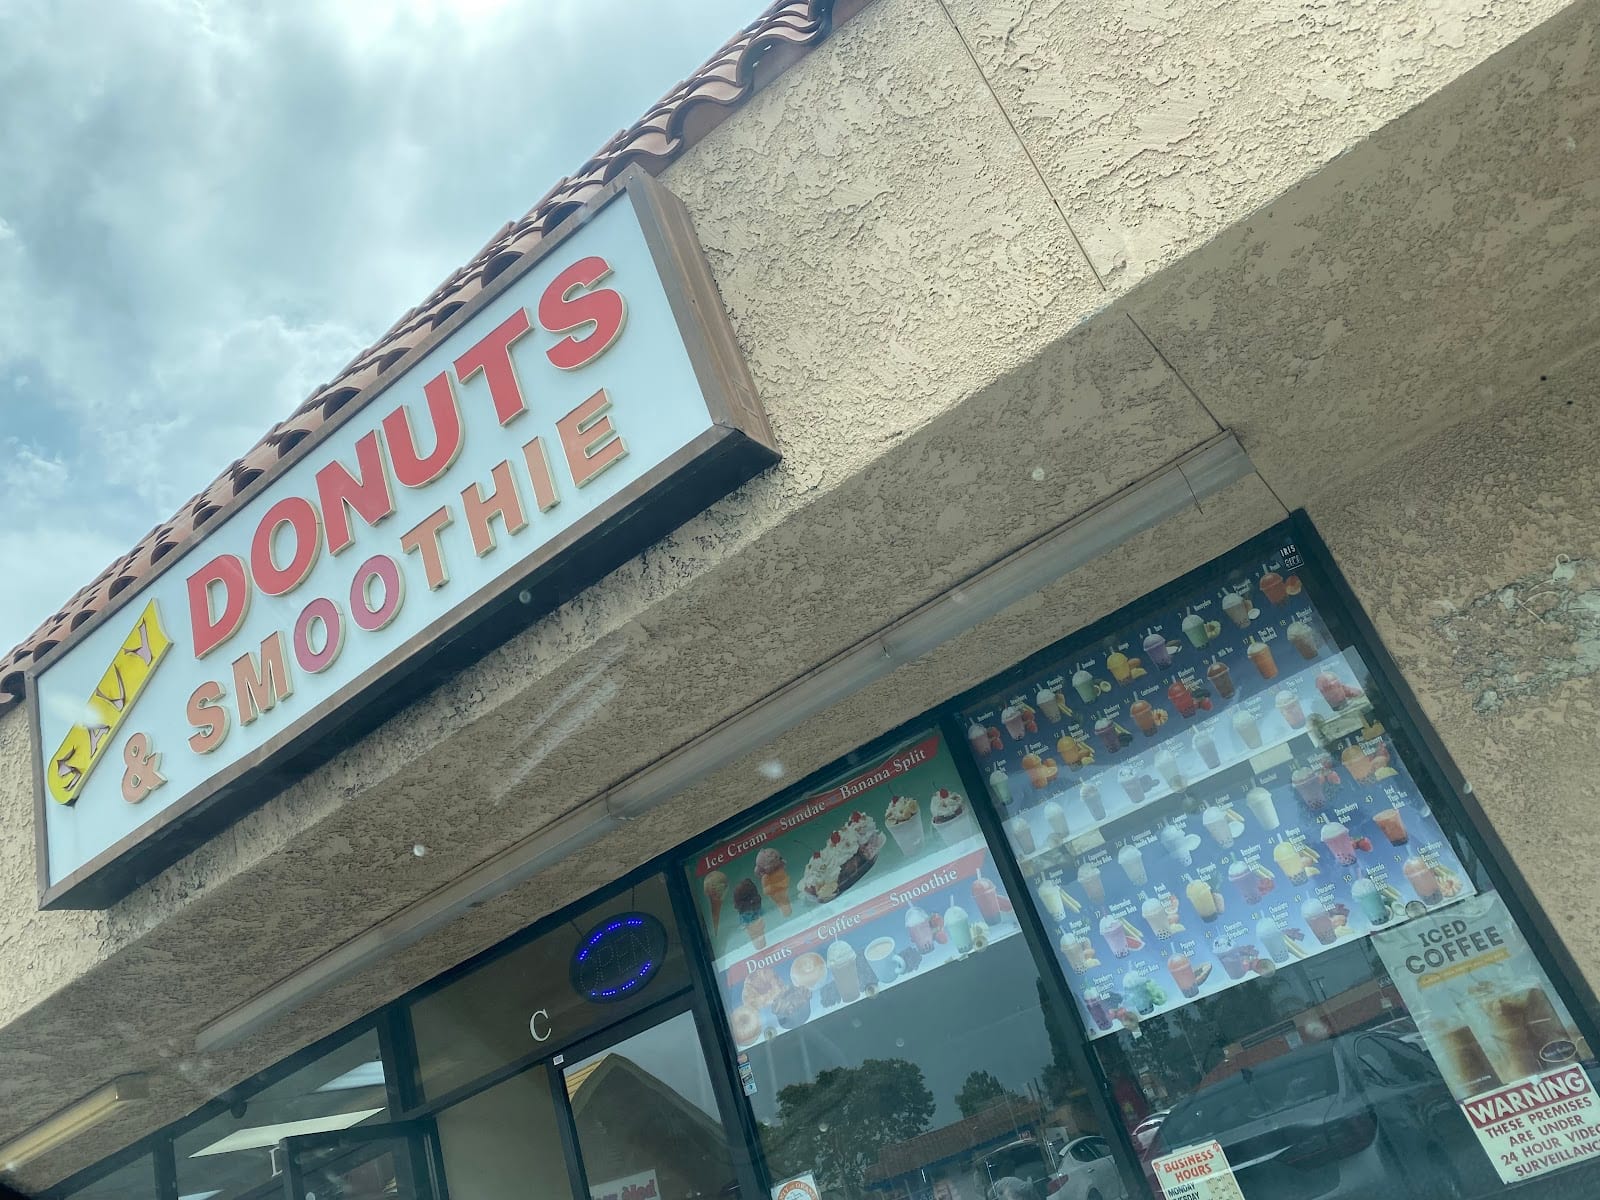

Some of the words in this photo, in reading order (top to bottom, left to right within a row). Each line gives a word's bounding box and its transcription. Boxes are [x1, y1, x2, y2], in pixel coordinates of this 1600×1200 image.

[186, 256, 628, 660] DONUTS
[122, 733, 168, 804] &
[187, 388, 629, 756] SMOOTHIE
[705, 852, 725, 870] Ice
[726, 830, 768, 858] Cream
[779, 800, 826, 831] Sundae
[839, 768, 891, 801] Banana
[892, 749, 927, 774] Split
[745, 946, 792, 975] Donuts
[816, 912, 862, 942] Coffee
[889, 868, 959, 908] Smoothie
[1418, 920, 1467, 947] ICED
[1405, 926, 1504, 974] COFFEE
[529, 1008, 551, 1042] C
[1468, 1072, 1585, 1123] WARNING
[1485, 1118, 1525, 1139] THESE
[1528, 1097, 1592, 1124] PREMISES
[1509, 1130, 1535, 1147] ARE
[1538, 1115, 1585, 1136] UNDER
[1501, 1152, 1518, 1167] 24
[1522, 1137, 1562, 1158] HOUR
[1515, 1139, 1600, 1177] SURVEILLANC
[1168, 1183, 1195, 1197] MONDAY
[1175, 1163, 1213, 1183] HOURS
[1172, 1192, 1200, 1200] ESDAY
